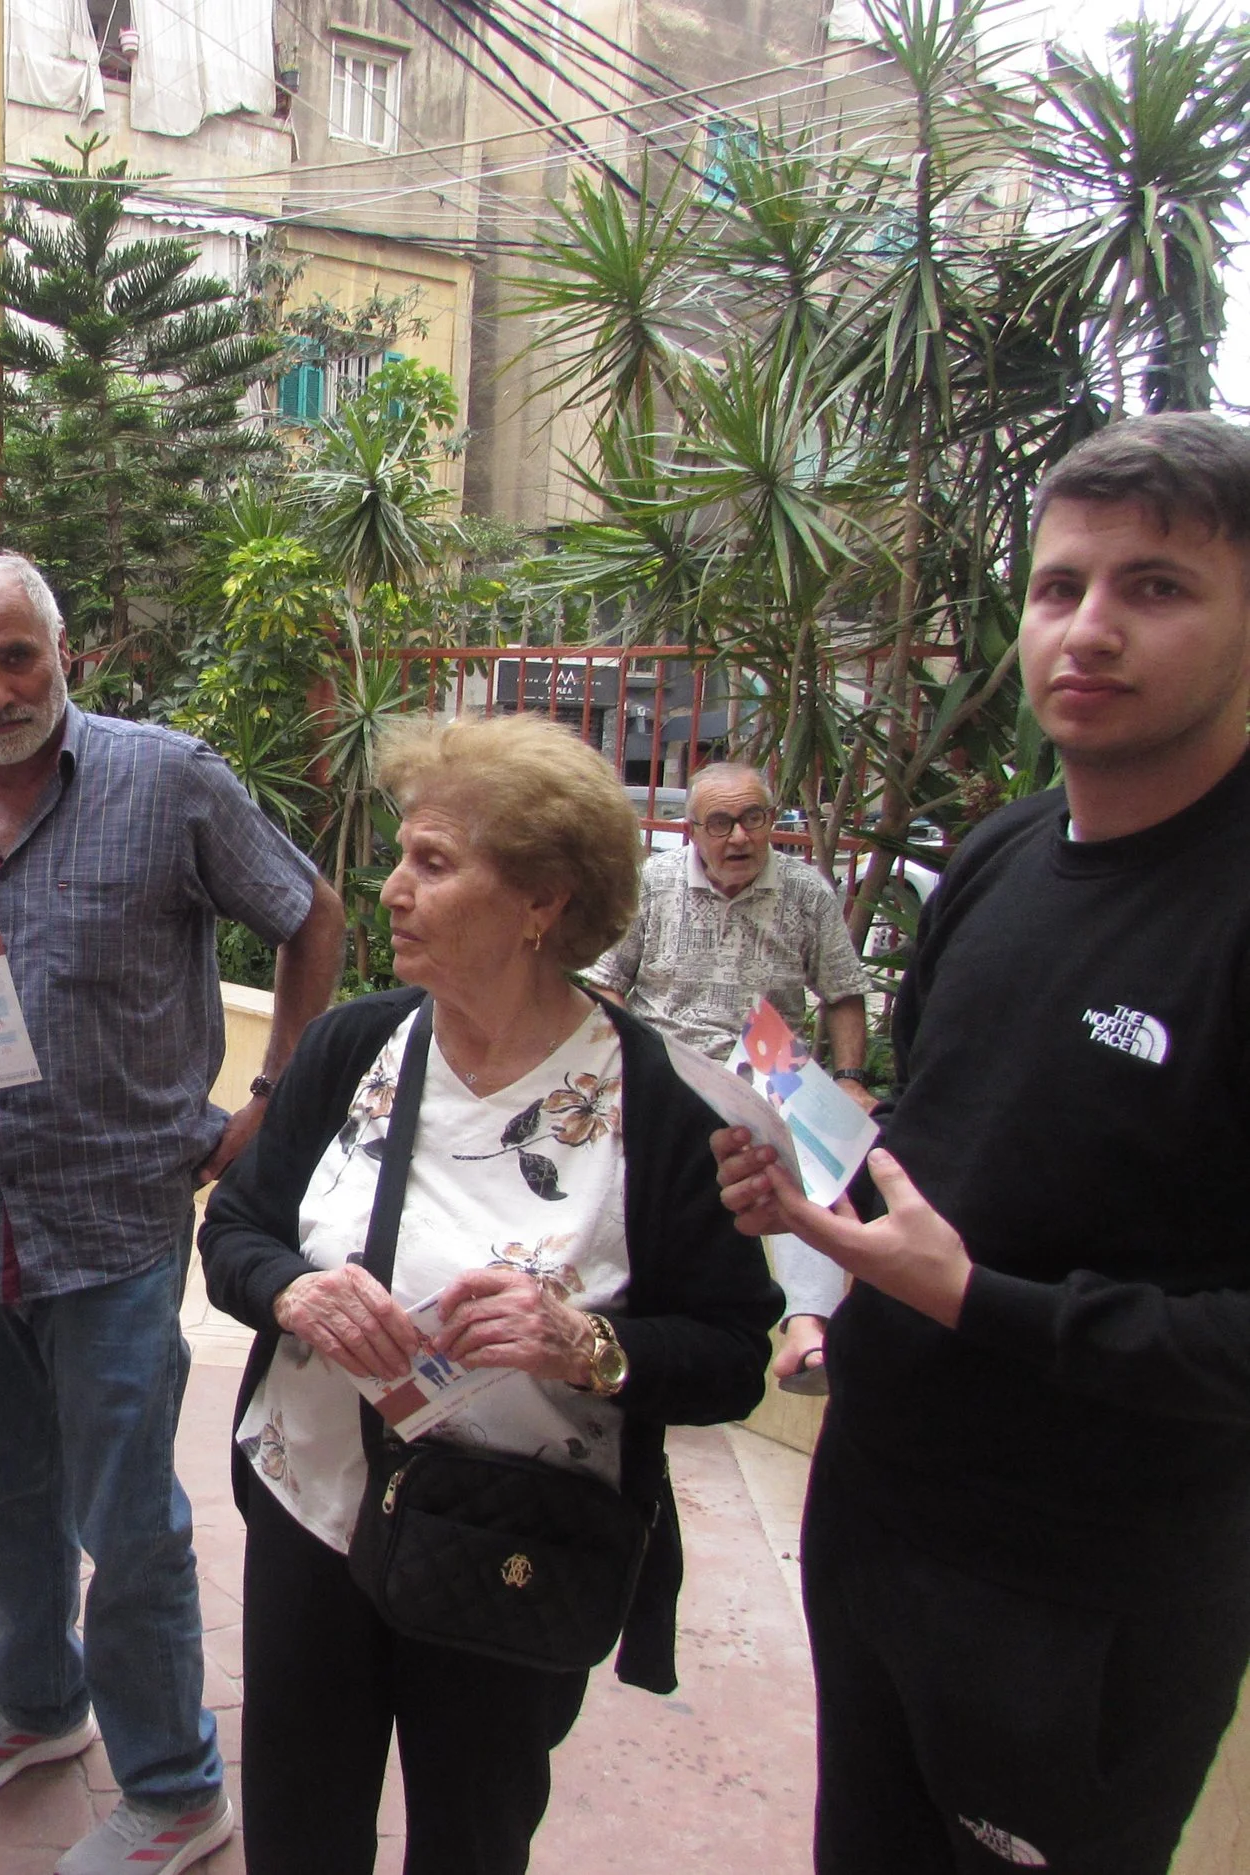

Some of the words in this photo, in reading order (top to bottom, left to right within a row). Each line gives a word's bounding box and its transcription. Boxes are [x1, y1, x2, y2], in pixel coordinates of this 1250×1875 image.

[1081, 1008, 1139, 1040] NORTH
[1114, 1004, 1145, 1026] THE
[1090, 1026, 1132, 1052] FACE
